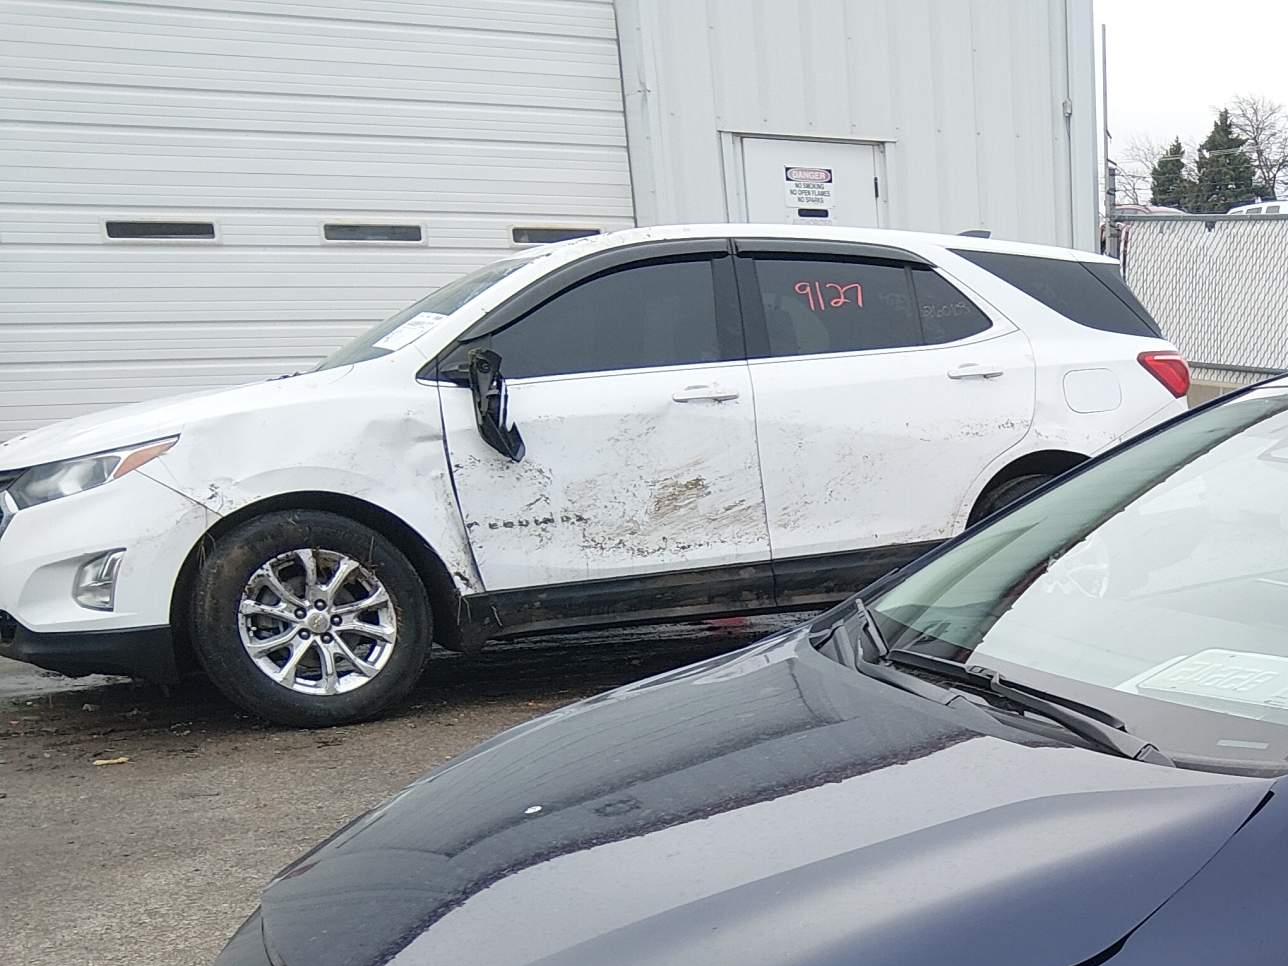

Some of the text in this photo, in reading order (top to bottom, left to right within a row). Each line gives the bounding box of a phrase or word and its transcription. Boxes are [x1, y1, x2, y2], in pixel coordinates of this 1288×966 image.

[792, 170, 826, 180] DANGER
[798, 189, 811, 197] OPEN
[794, 281, 864, 312] 9127
